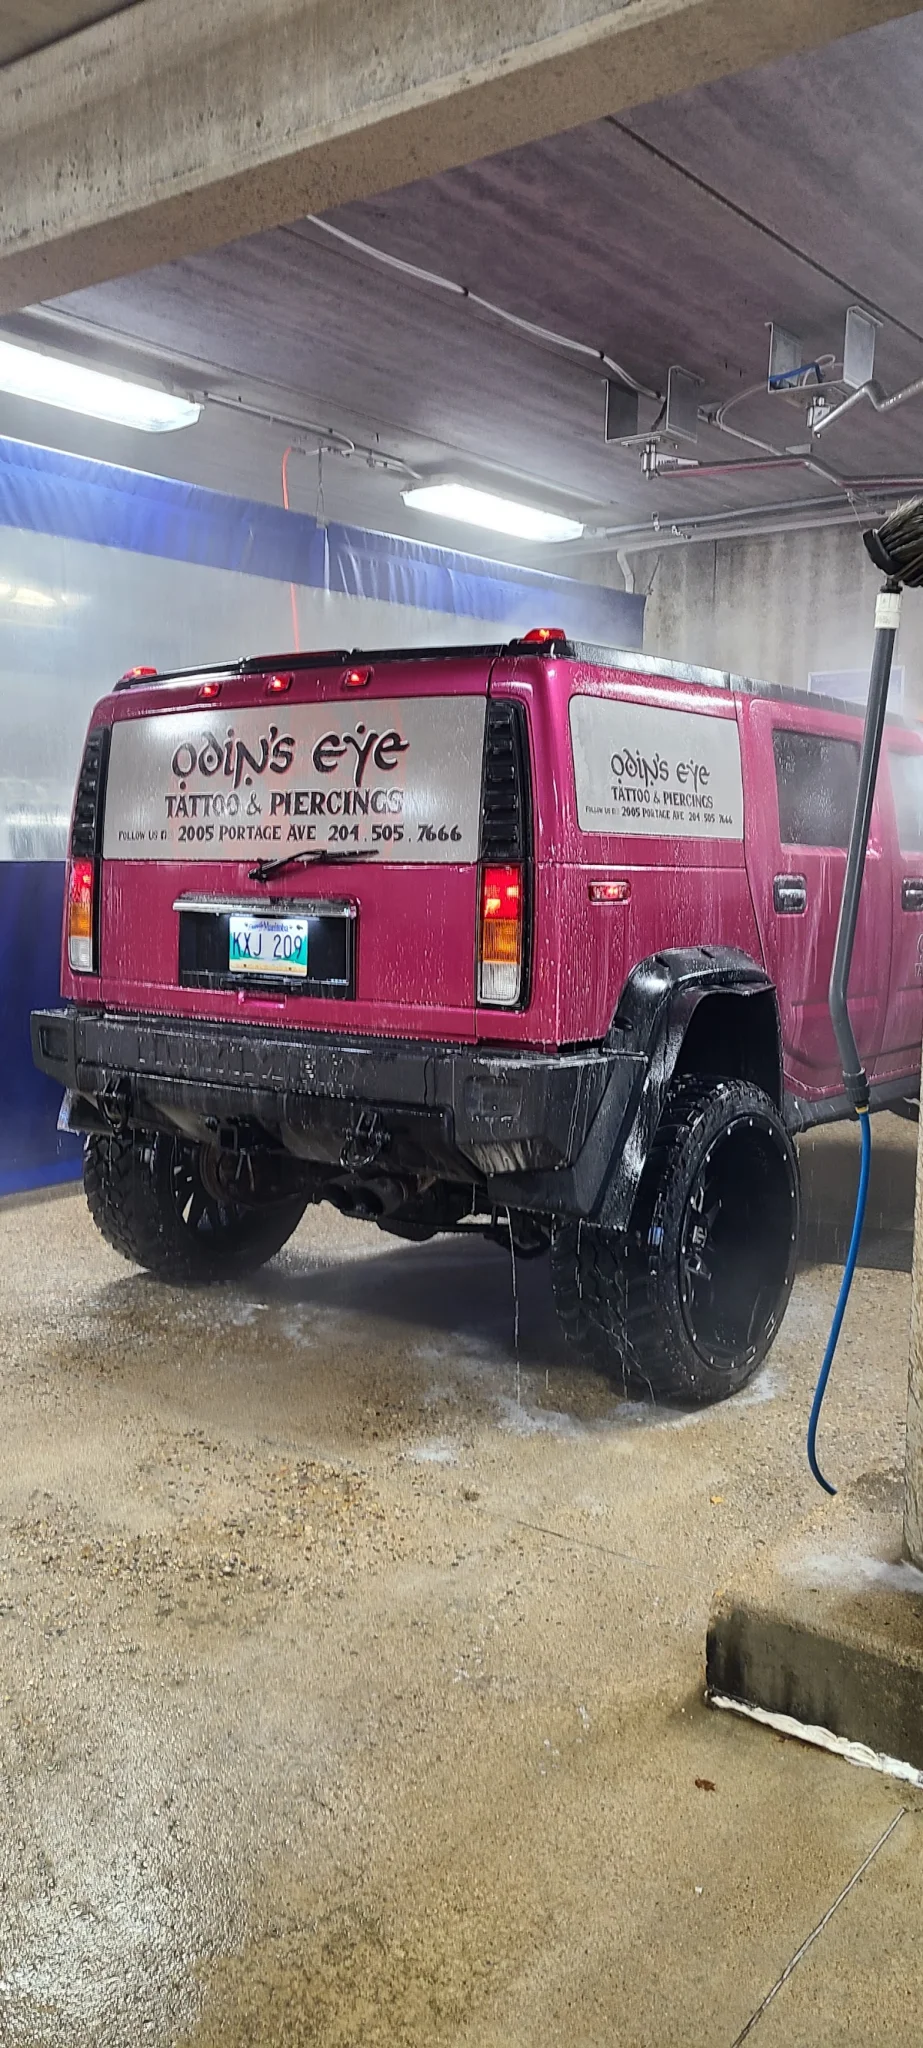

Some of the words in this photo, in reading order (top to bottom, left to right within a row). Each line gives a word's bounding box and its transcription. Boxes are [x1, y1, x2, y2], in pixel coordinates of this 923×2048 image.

[165, 794, 239, 818] TATTOO
[246, 792, 262, 815] &
[270, 788, 404, 816] PIERCINGS
[611, 785, 651, 803] TATTOO
[663, 791, 714, 809] PIERCINGS
[621, 806, 641, 817] 2005
[178, 825, 214, 842] 2005
[219, 824, 281, 841] PORTAGE
[287, 824, 316, 840] AVE
[232, 931, 262, 957] KXJ
[273, 934, 303, 960] 209
